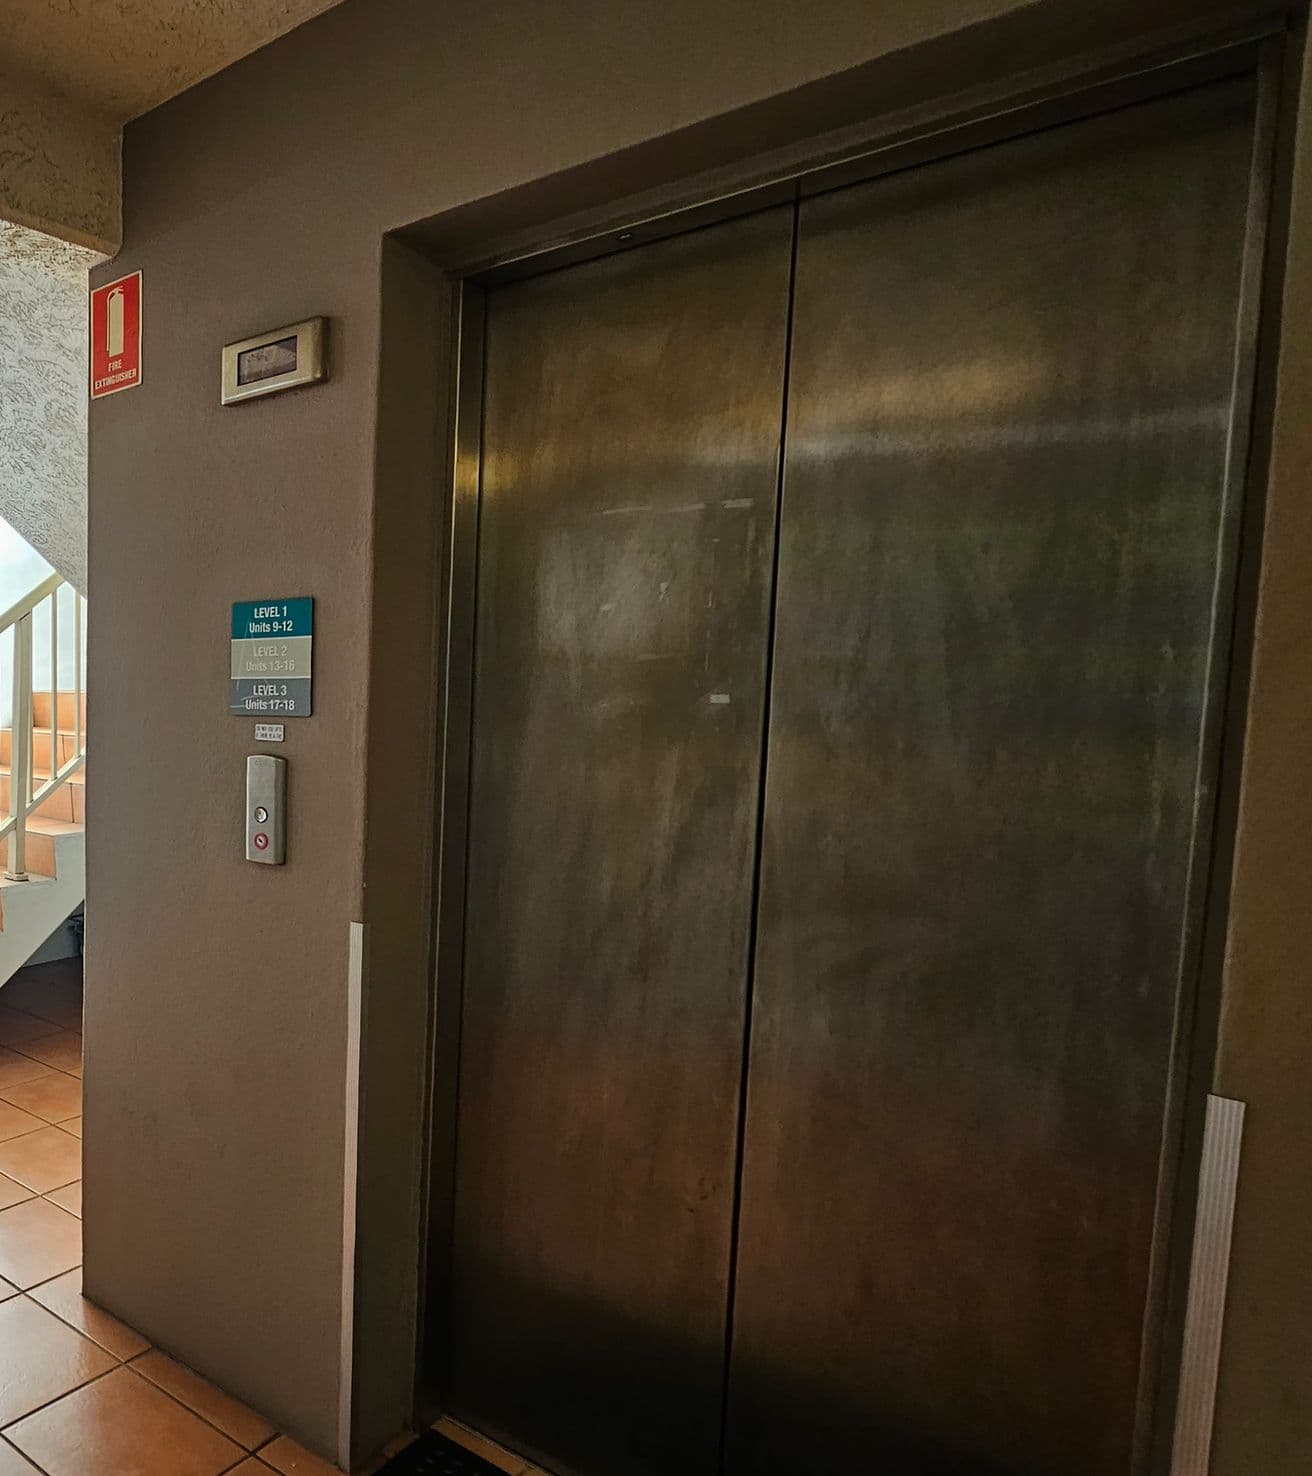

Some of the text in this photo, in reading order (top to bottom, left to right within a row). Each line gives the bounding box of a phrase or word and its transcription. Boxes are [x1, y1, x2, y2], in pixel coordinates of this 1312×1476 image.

[108, 359, 122, 372] FIRE
[95, 368, 137, 390] EXTINGUISHER
[254, 605, 287, 619] LEVEL 1
[249, 620, 293, 633] Units 9-12
[253, 645, 288, 657] LEVEL 2
[246, 661, 268, 672] Units
[253, 684, 288, 696] LEVEL 3
[245, 699, 295, 711] Units 17-18
